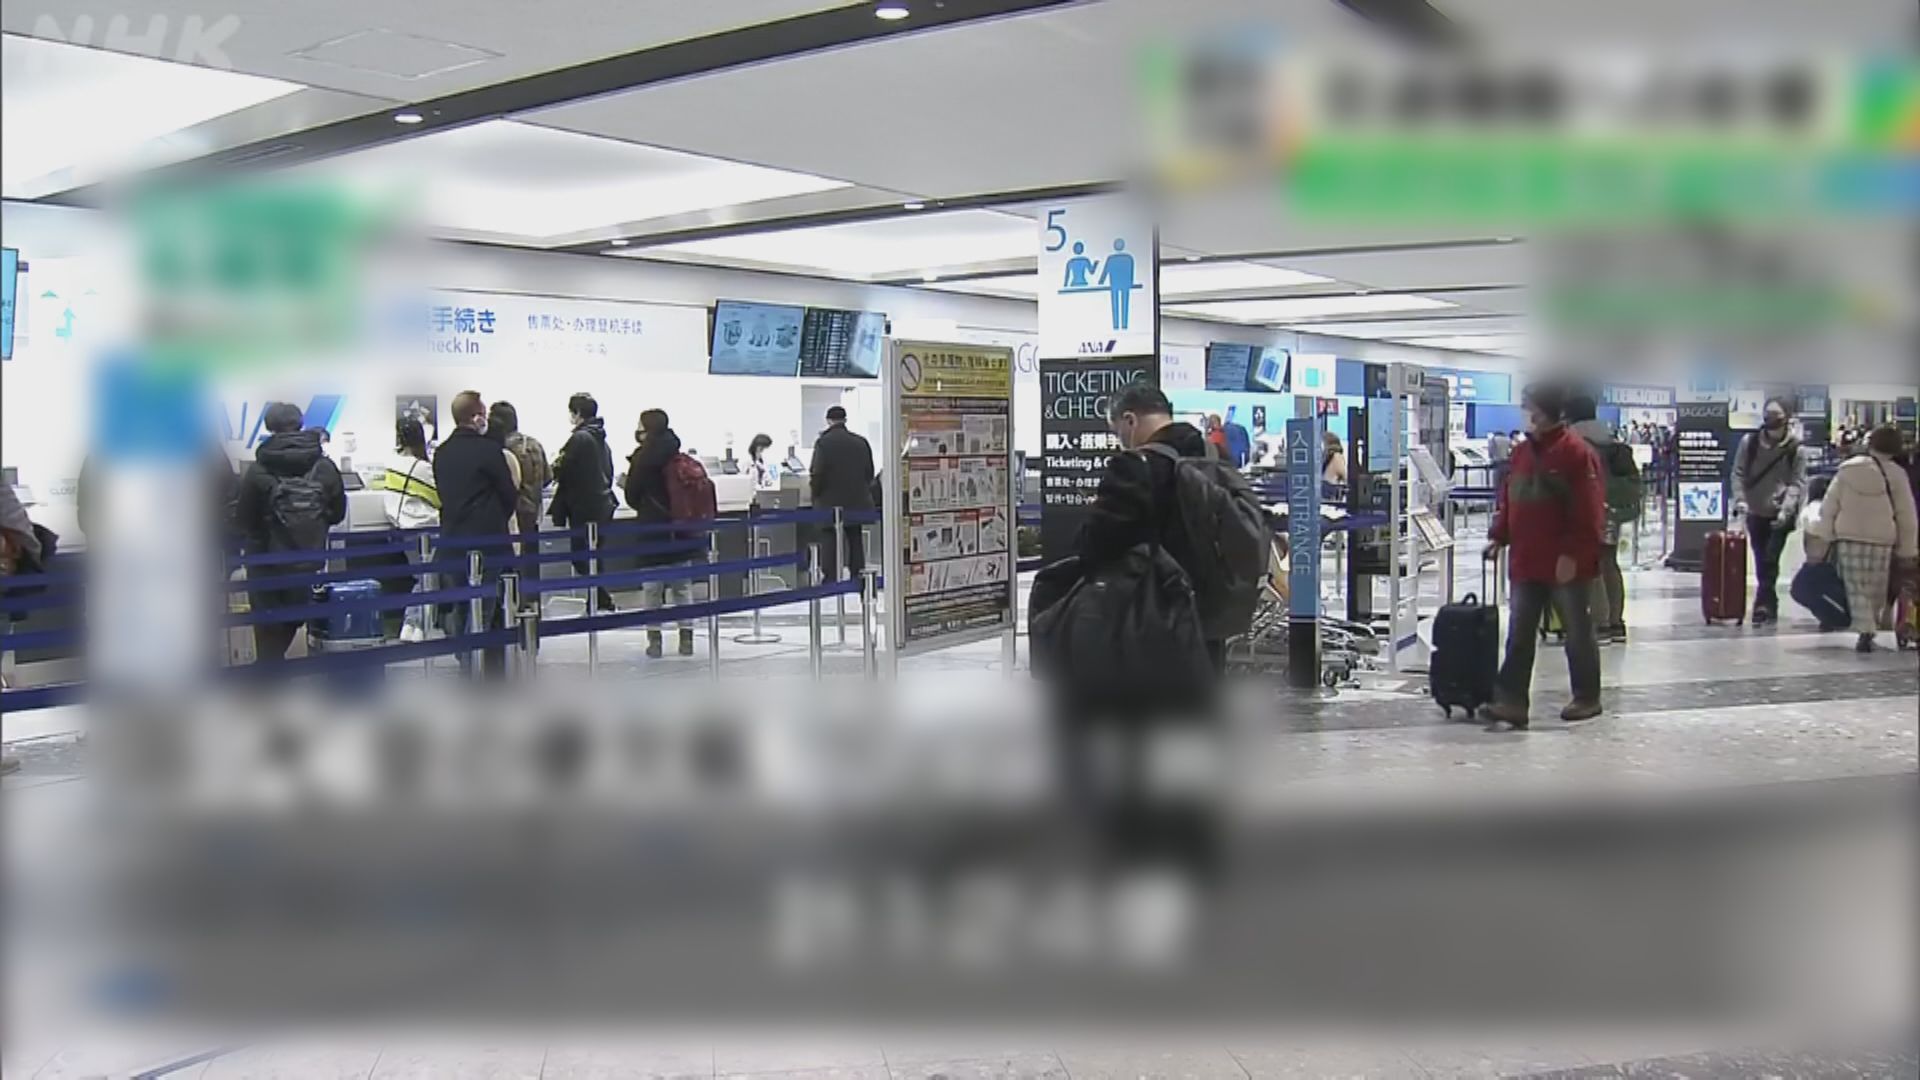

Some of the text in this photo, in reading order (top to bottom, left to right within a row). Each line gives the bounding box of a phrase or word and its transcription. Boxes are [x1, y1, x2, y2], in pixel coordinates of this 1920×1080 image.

[1046, 209, 1067, 252] 5
[427, 305, 498, 334] 手続き
[427, 336, 480, 355] heck In
[1078, 341, 1105, 353] ANA
[1044, 396, 1112, 420] &CHEC
[1045, 456, 1092, 472] Ticketing
[1093, 456, 1102, 468] &
[1291, 430, 1311, 576] 入口 ENTRANCE
